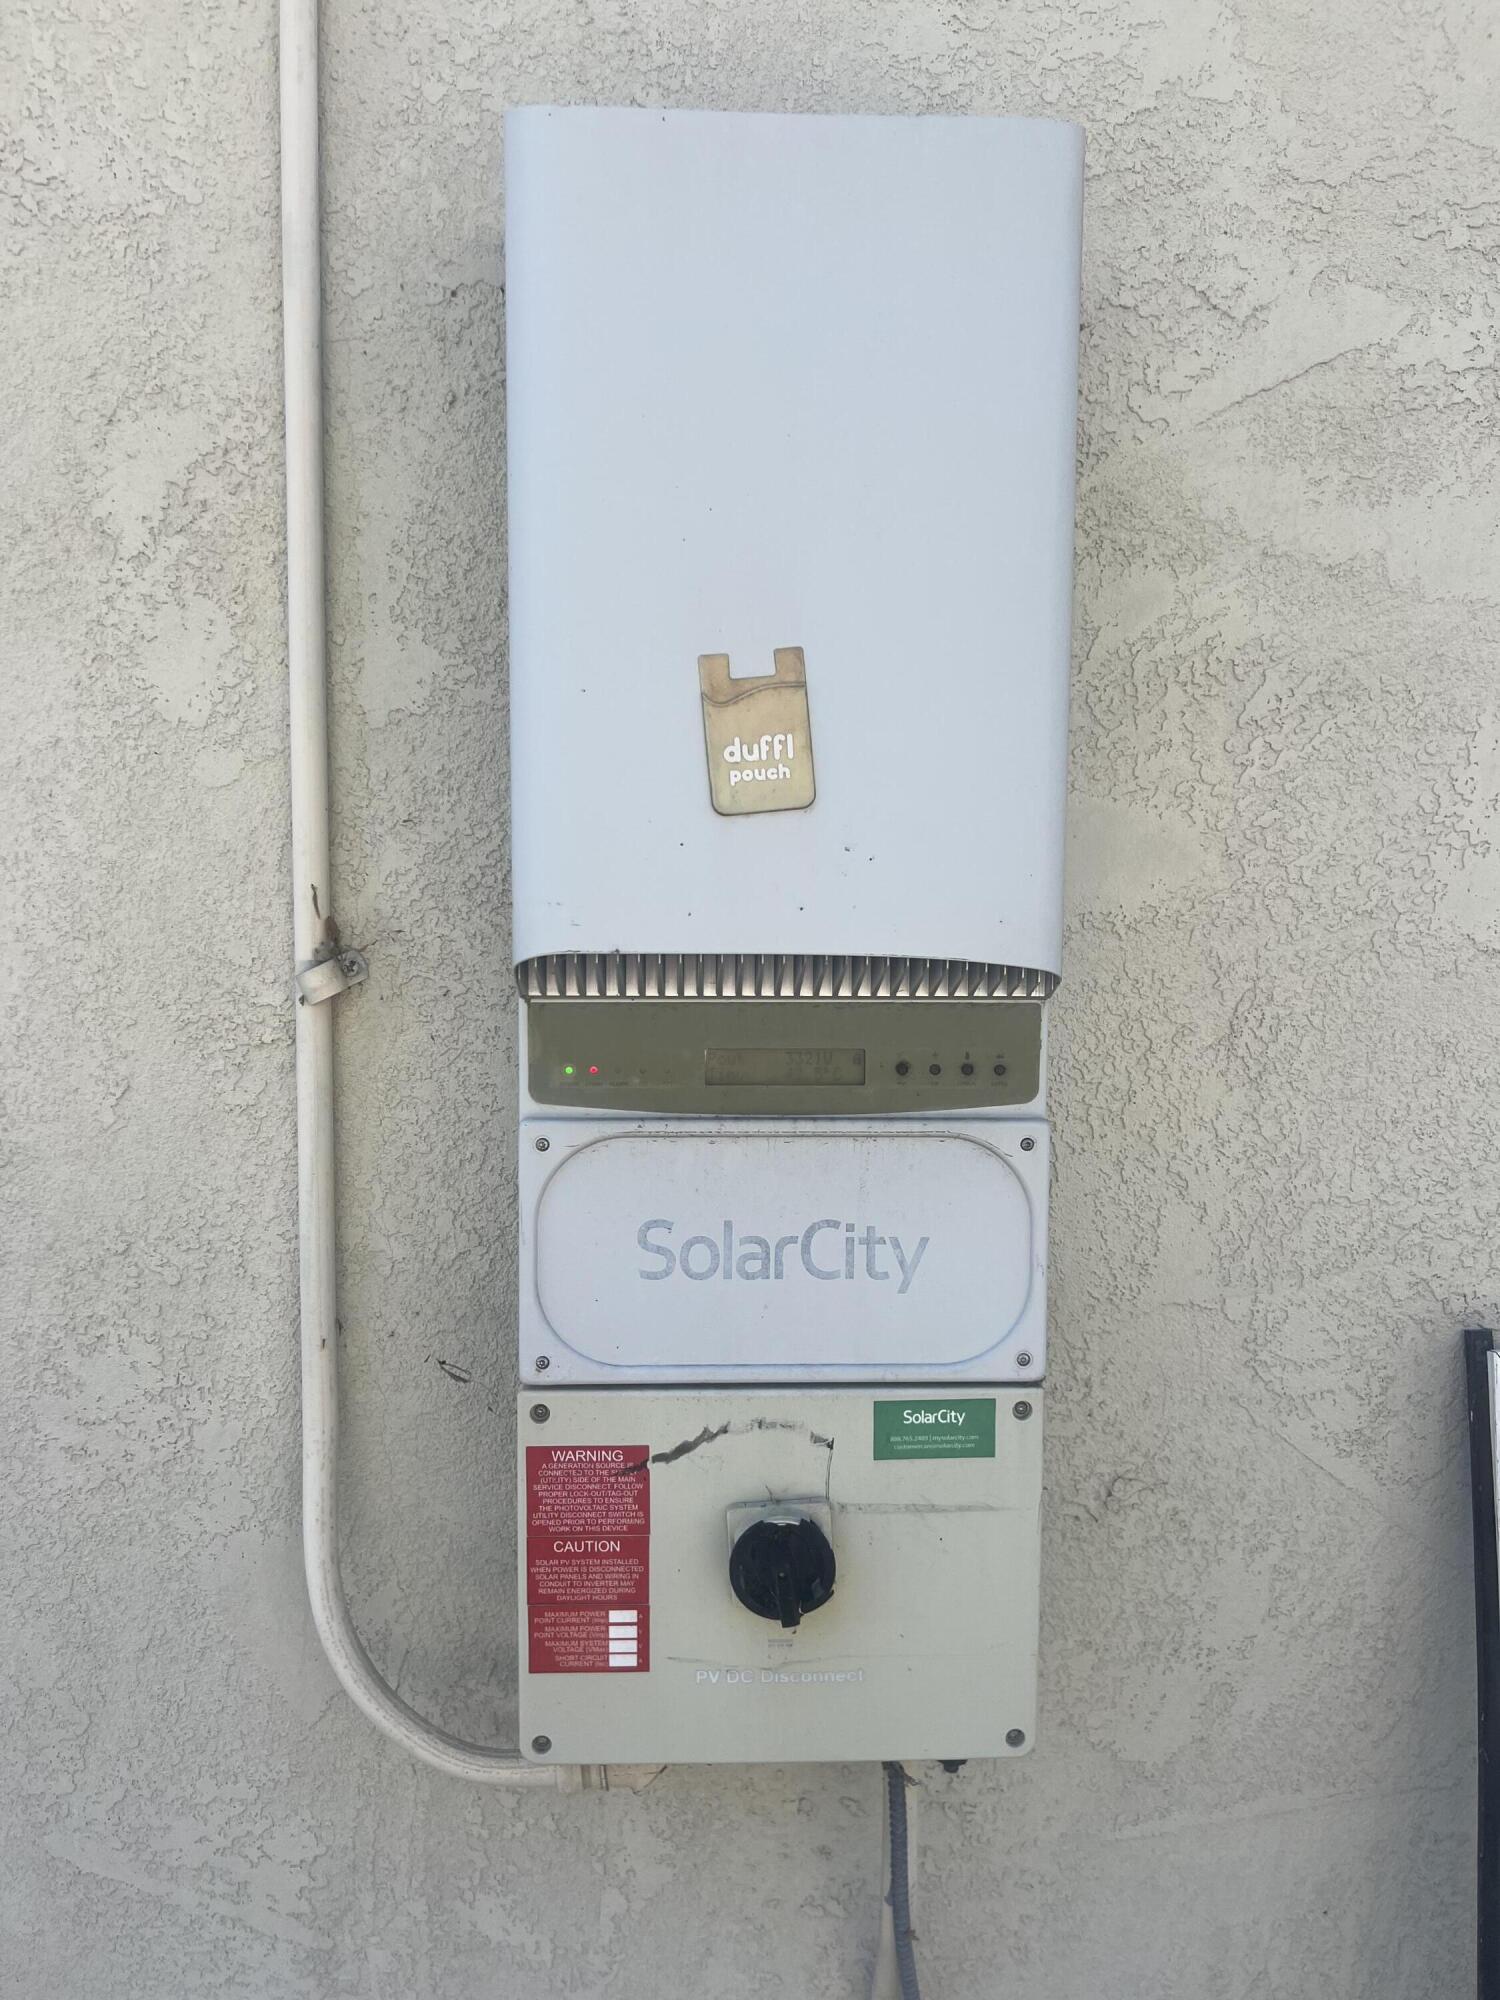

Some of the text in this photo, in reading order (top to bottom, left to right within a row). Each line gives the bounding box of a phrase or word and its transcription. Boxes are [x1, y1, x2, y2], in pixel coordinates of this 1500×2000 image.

[723, 733, 794, 763] duffl
[729, 763, 791, 787] pouch
[636, 1218, 930, 1295] SolarCity
[903, 1409, 966, 1426] SolarCity
[551, 1450, 624, 1462] WARNING
[553, 1540, 621, 1553] CAUTION
[695, 1669, 863, 1684] PV DC Disconnect
